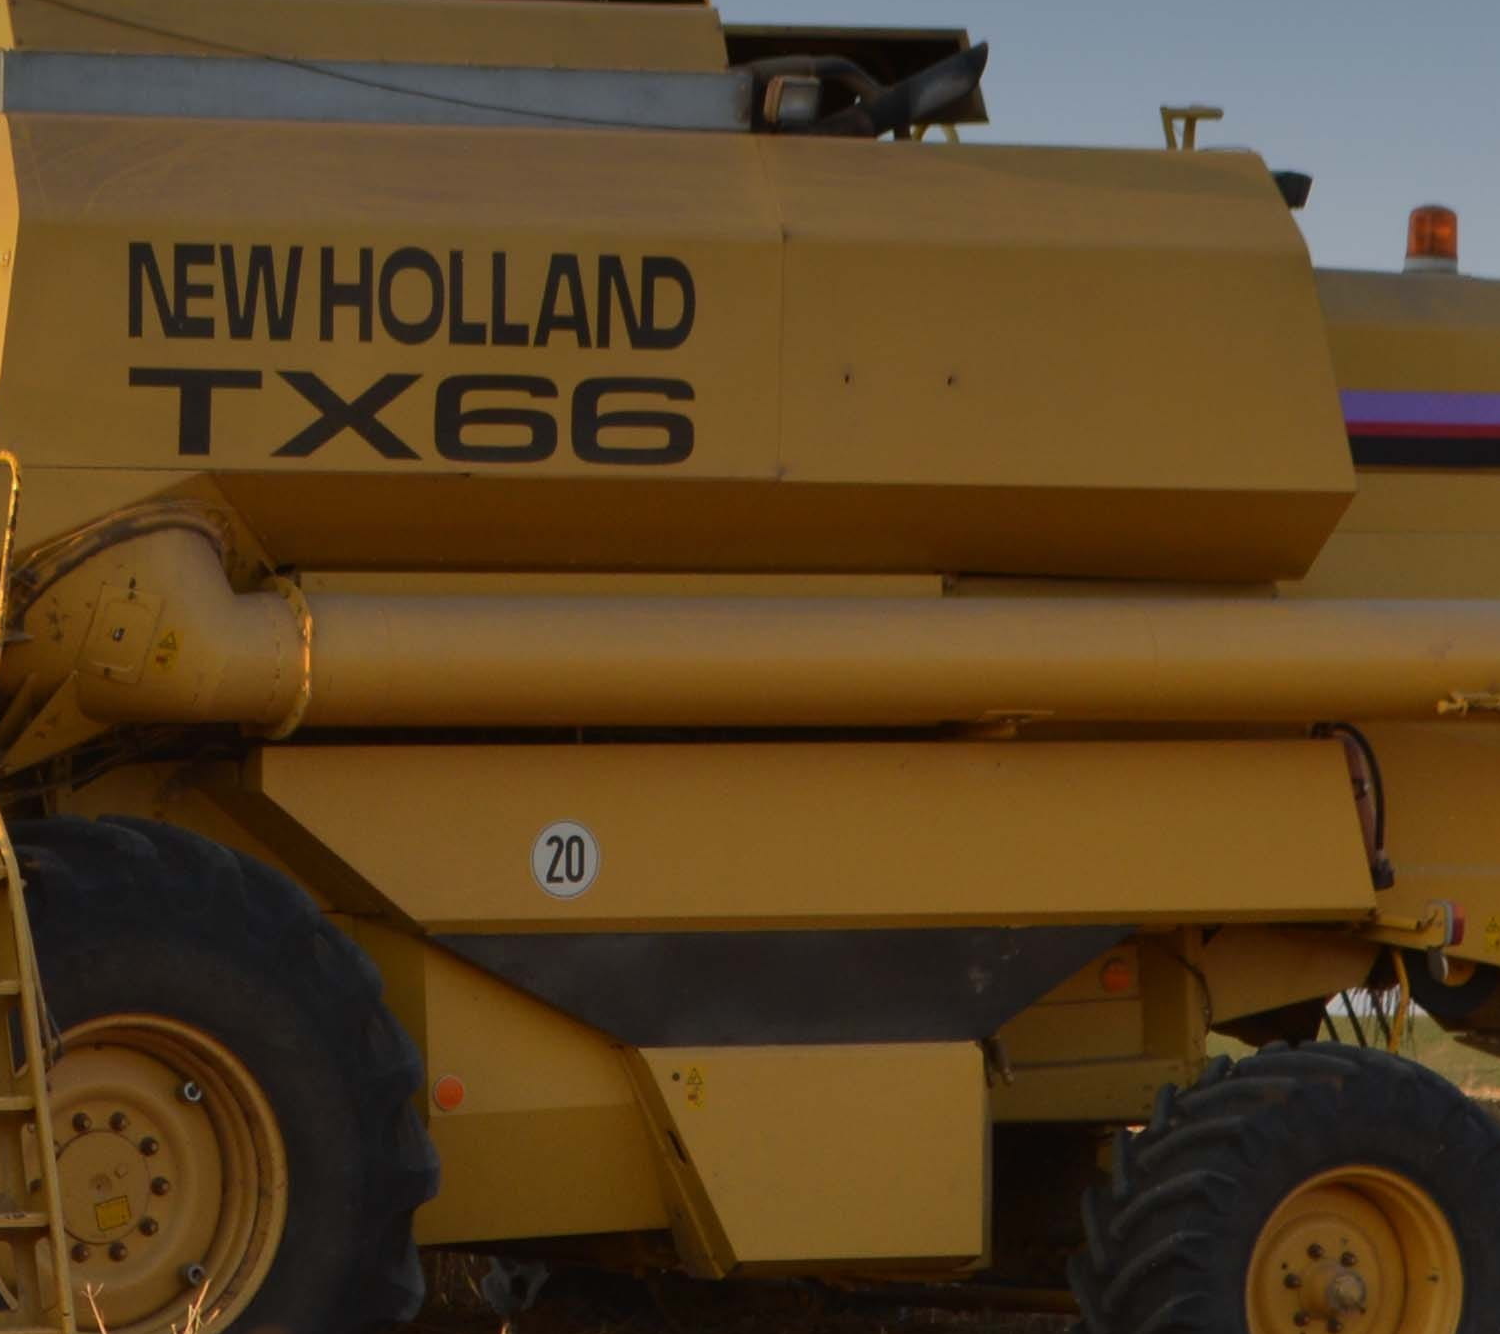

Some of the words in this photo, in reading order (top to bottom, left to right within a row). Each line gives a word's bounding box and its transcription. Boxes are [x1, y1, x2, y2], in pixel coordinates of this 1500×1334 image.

[128, 242, 304, 342] NEW
[319, 246, 696, 350] HOLLAND
[128, 367, 696, 465] TX66
[546, 835, 585, 883] 20
